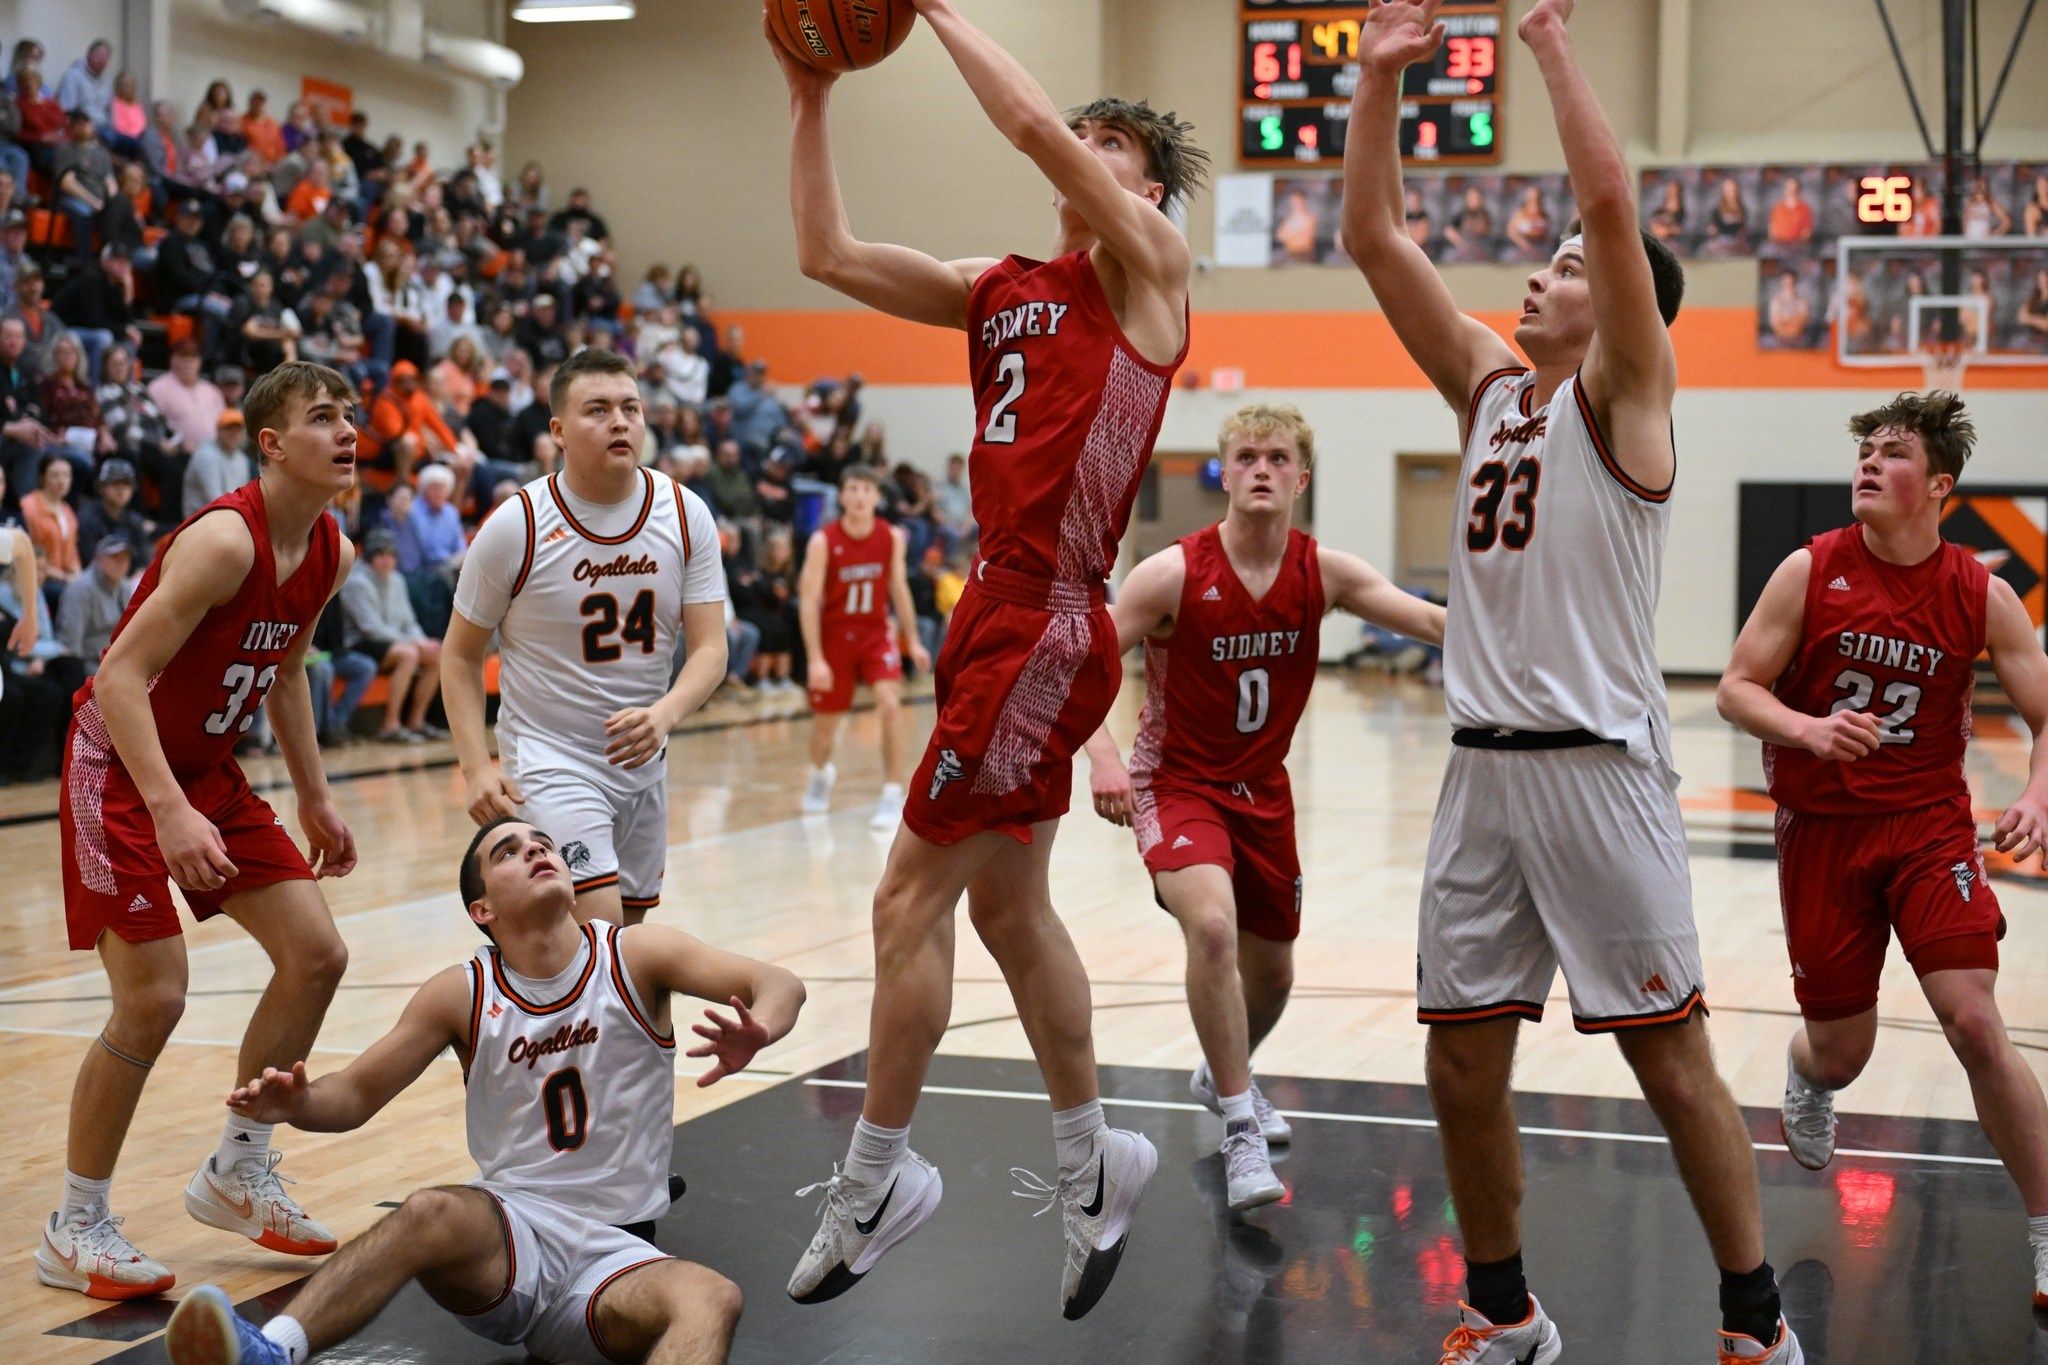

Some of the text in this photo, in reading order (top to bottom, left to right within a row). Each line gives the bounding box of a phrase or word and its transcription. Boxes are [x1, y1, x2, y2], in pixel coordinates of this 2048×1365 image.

[804, 29, 829, 56] PRO
[1312, 20, 1360, 58] 47
[1446, 36, 1496, 77] 33
[1253, 42, 1302, 83] 61
[1260, 116, 1284, 150] 5
[1469, 112, 1493, 146] 5
[1858, 176, 1912, 223] 26
[982, 302, 1068, 350] SIDNEY
[984, 353, 1026, 443] 2
[1467, 455, 1541, 552] 33
[573, 554, 658, 588] Ogallala
[845, 582, 874, 614] 11
[579, 588, 656, 664] 24
[1212, 631, 1300, 662] SIDNEY
[1837, 631, 1944, 677] SIDNEY
[1236, 668, 1269, 733] 0
[1830, 669, 1922, 744] 22
[508, 1018, 598, 1070] Ogallala
[542, 1065, 588, 1153] 0
